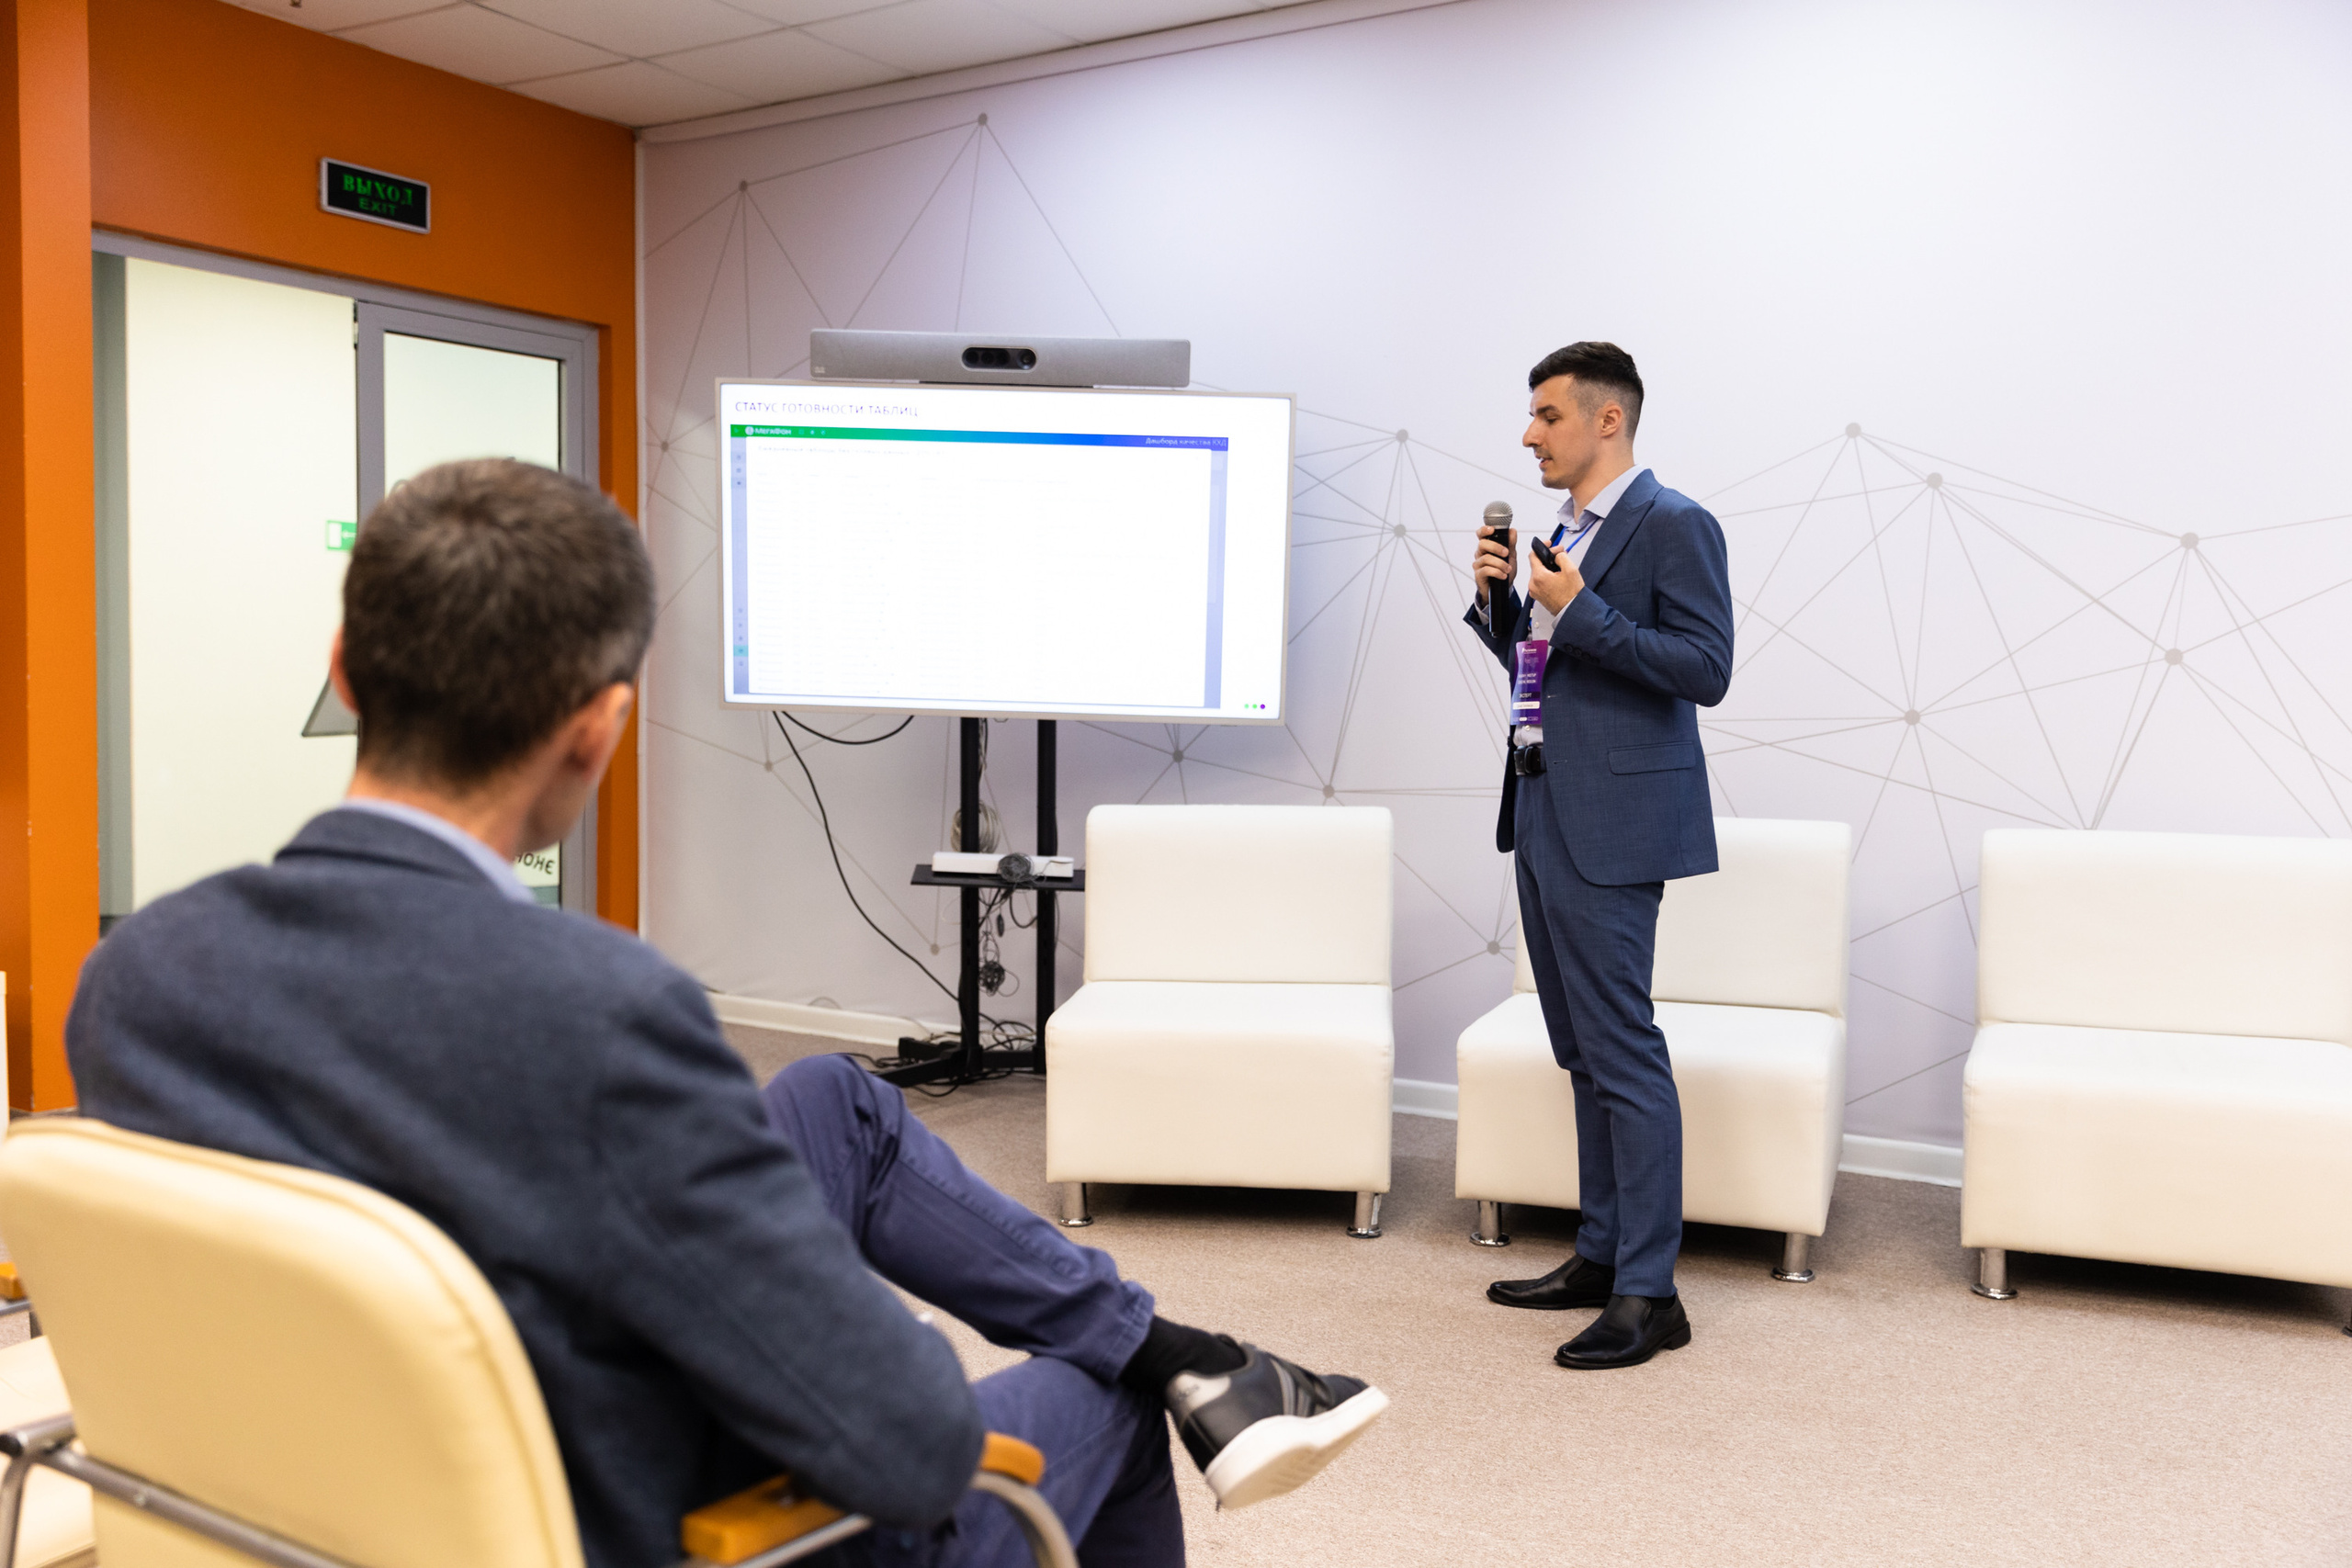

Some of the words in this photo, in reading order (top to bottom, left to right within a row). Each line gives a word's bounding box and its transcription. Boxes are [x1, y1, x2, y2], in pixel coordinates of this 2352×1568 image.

[344, 175, 413, 205] ВЫХОД
[359, 197, 396, 215] EXIT
[735, 401, 778, 412] СТАТУС
[782, 402, 864, 414] ГОТОВНОСТИ
[868, 405, 918, 417] ТАБЛИЦ
[1146, 437, 1178, 446] Дашборд
